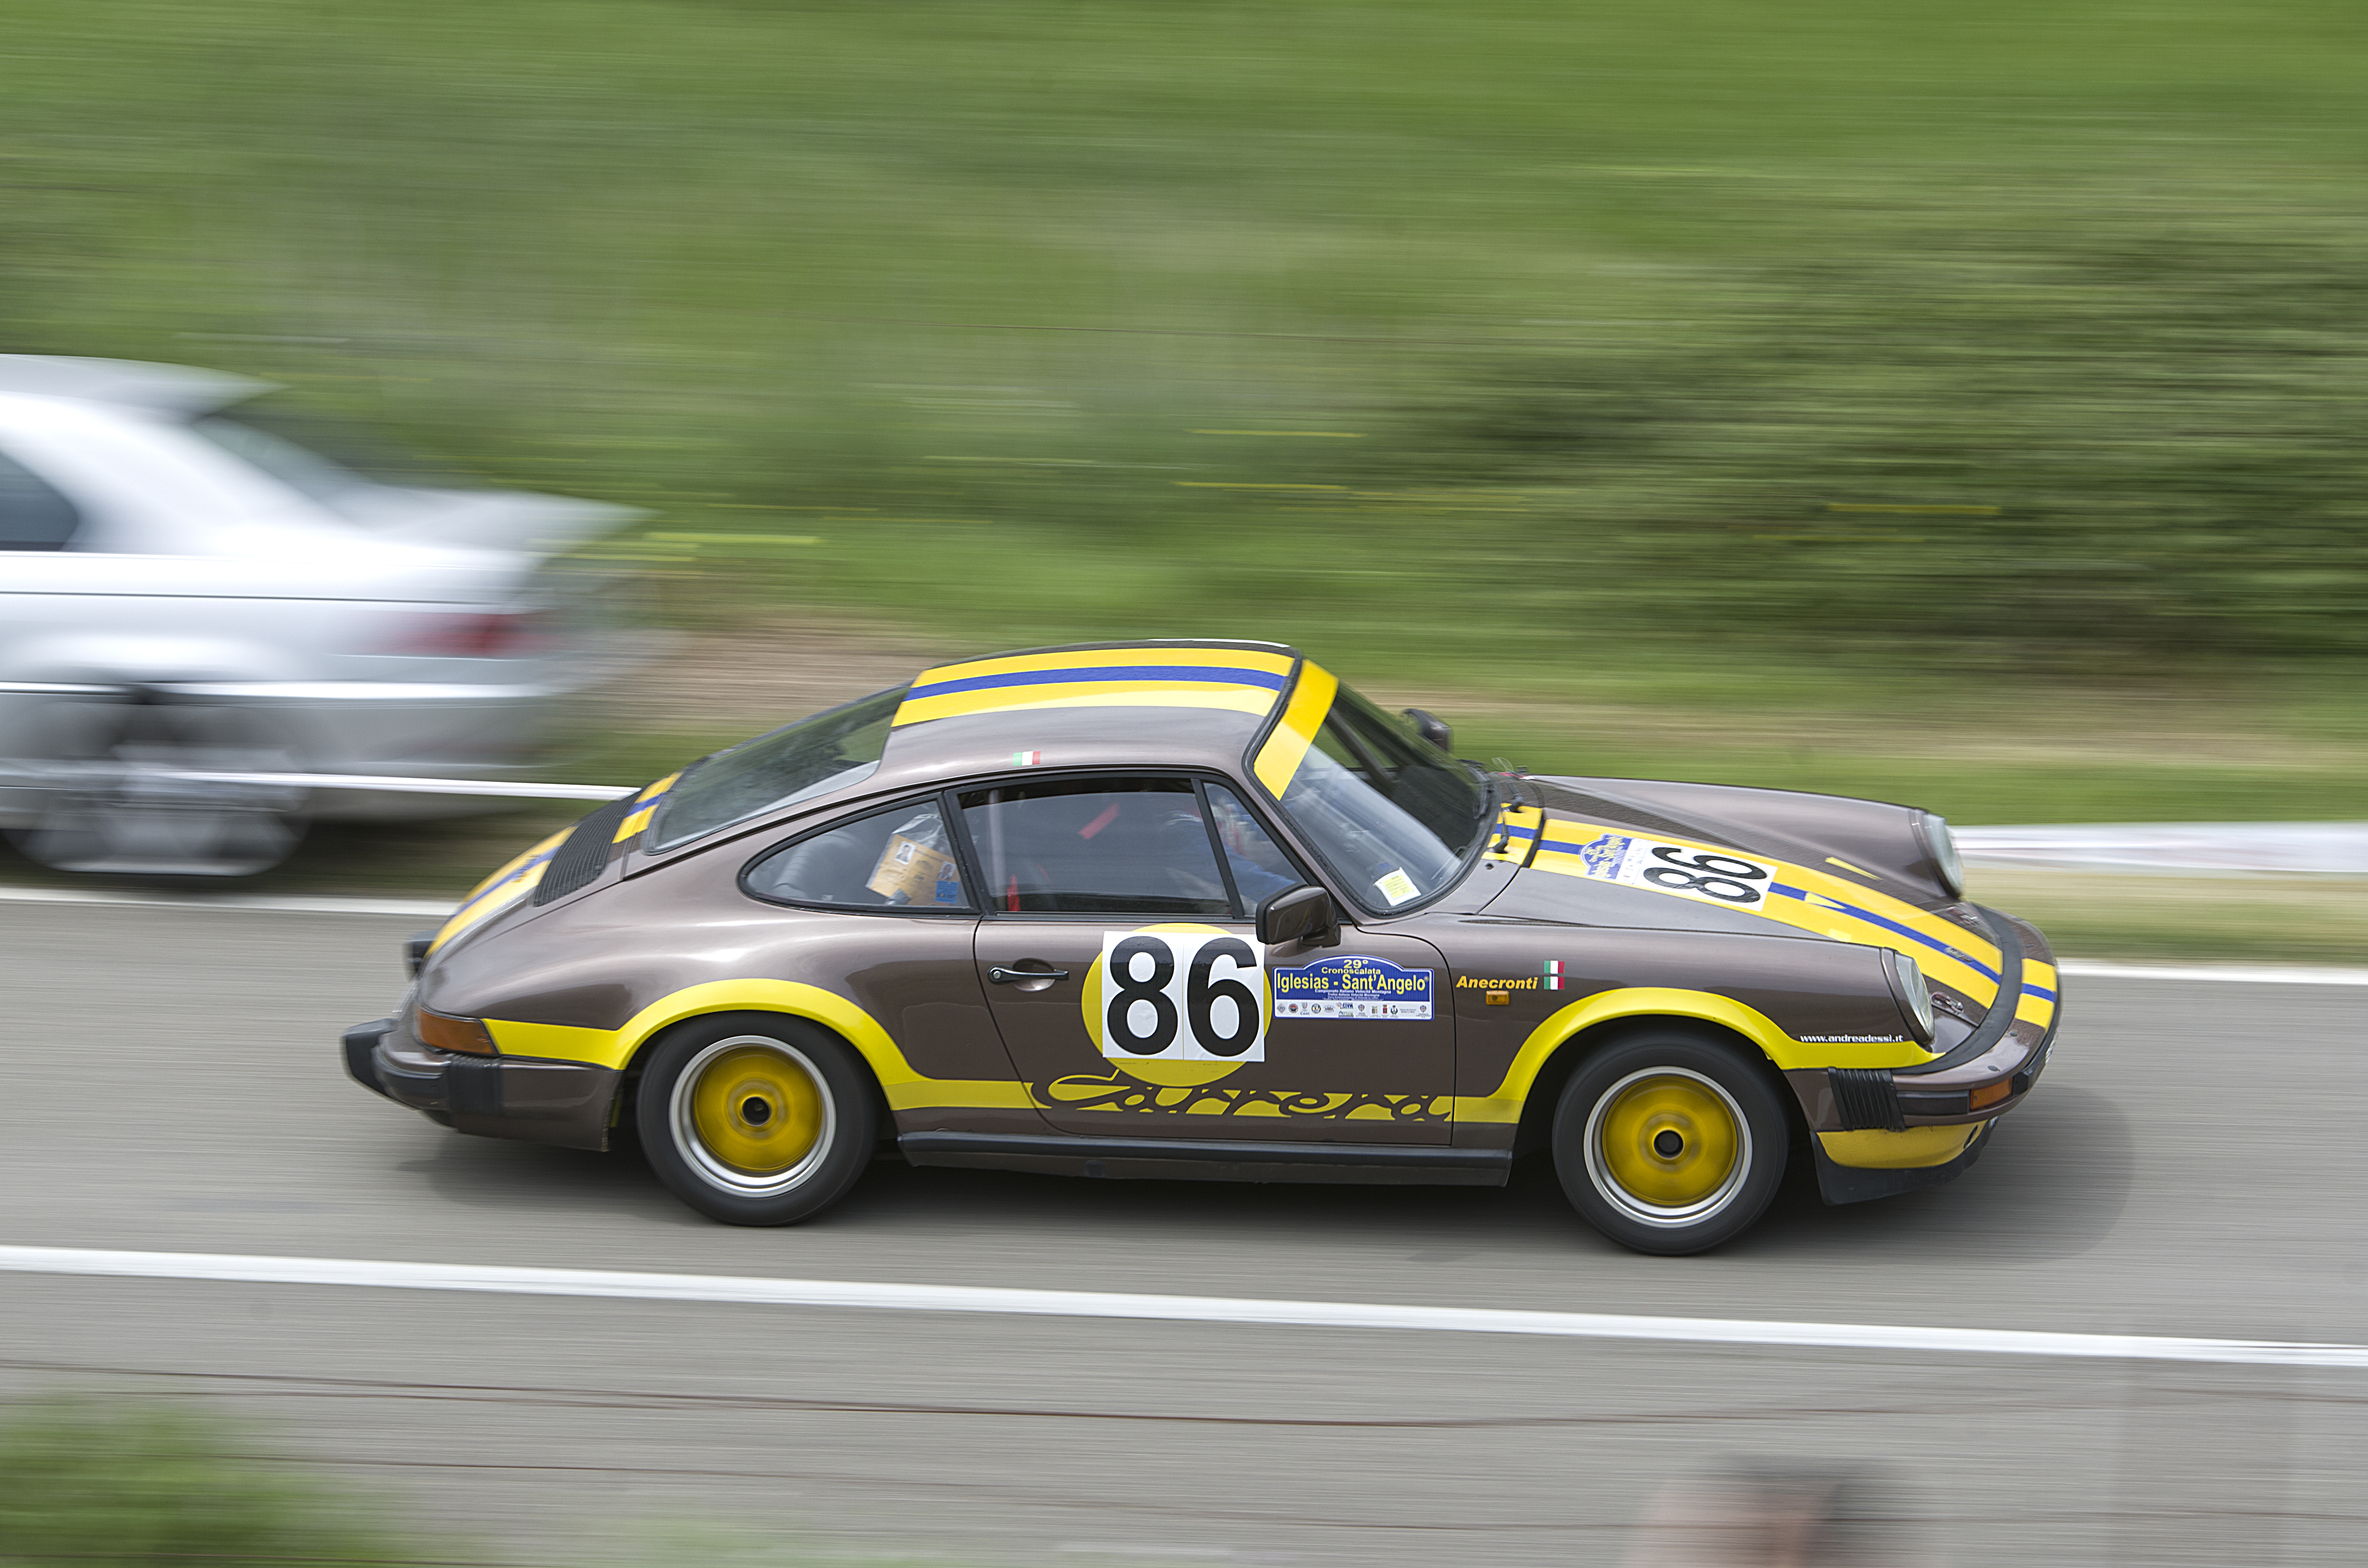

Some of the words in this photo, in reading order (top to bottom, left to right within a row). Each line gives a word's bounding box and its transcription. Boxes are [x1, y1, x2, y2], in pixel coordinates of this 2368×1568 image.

[1643, 847, 1767, 903] 86
[1321, 967, 1381, 975] Cronoscalata
[1344, 959, 1369, 969] 29°
[1277, 973, 1329, 993] Iglesias
[1456, 976, 1538, 989] Anecronti
[1107, 936, 1259, 1057] 86
[1032, 1069, 1453, 1123] Carrera
